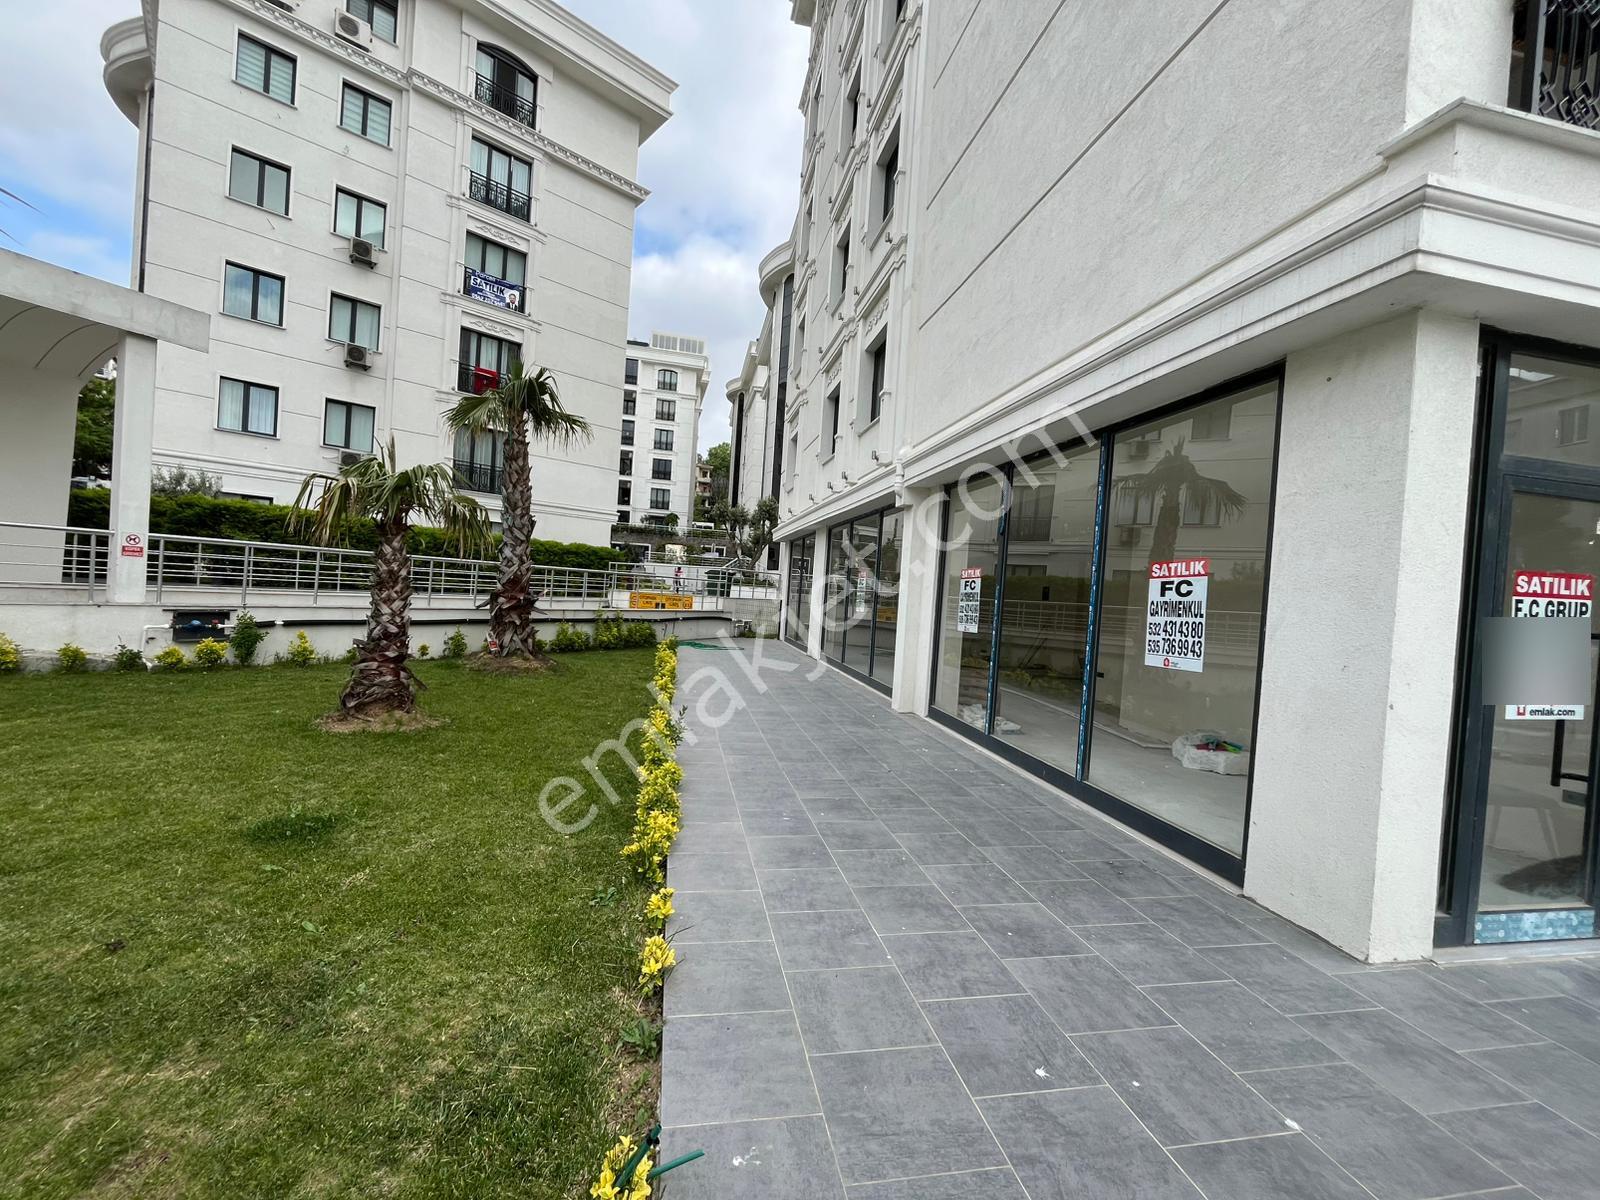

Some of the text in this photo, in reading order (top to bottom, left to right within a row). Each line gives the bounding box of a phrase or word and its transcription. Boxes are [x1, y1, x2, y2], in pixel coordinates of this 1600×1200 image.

[472, 277, 505, 296] SATILIK
[1151, 560, 1206, 577] SATILIK
[964, 580, 976, 590] FC
[1160, 579, 1194, 597] FC
[1516, 575, 1591, 596] SATILIK
[1149, 598, 1204, 618] GAYRİMENKUL
[1544, 600, 1589, 617] GRUP
[1148, 622, 1161, 636] 532
[1147, 639, 1160, 653] 535
[1529, 707, 1576, 717] emlak.com
